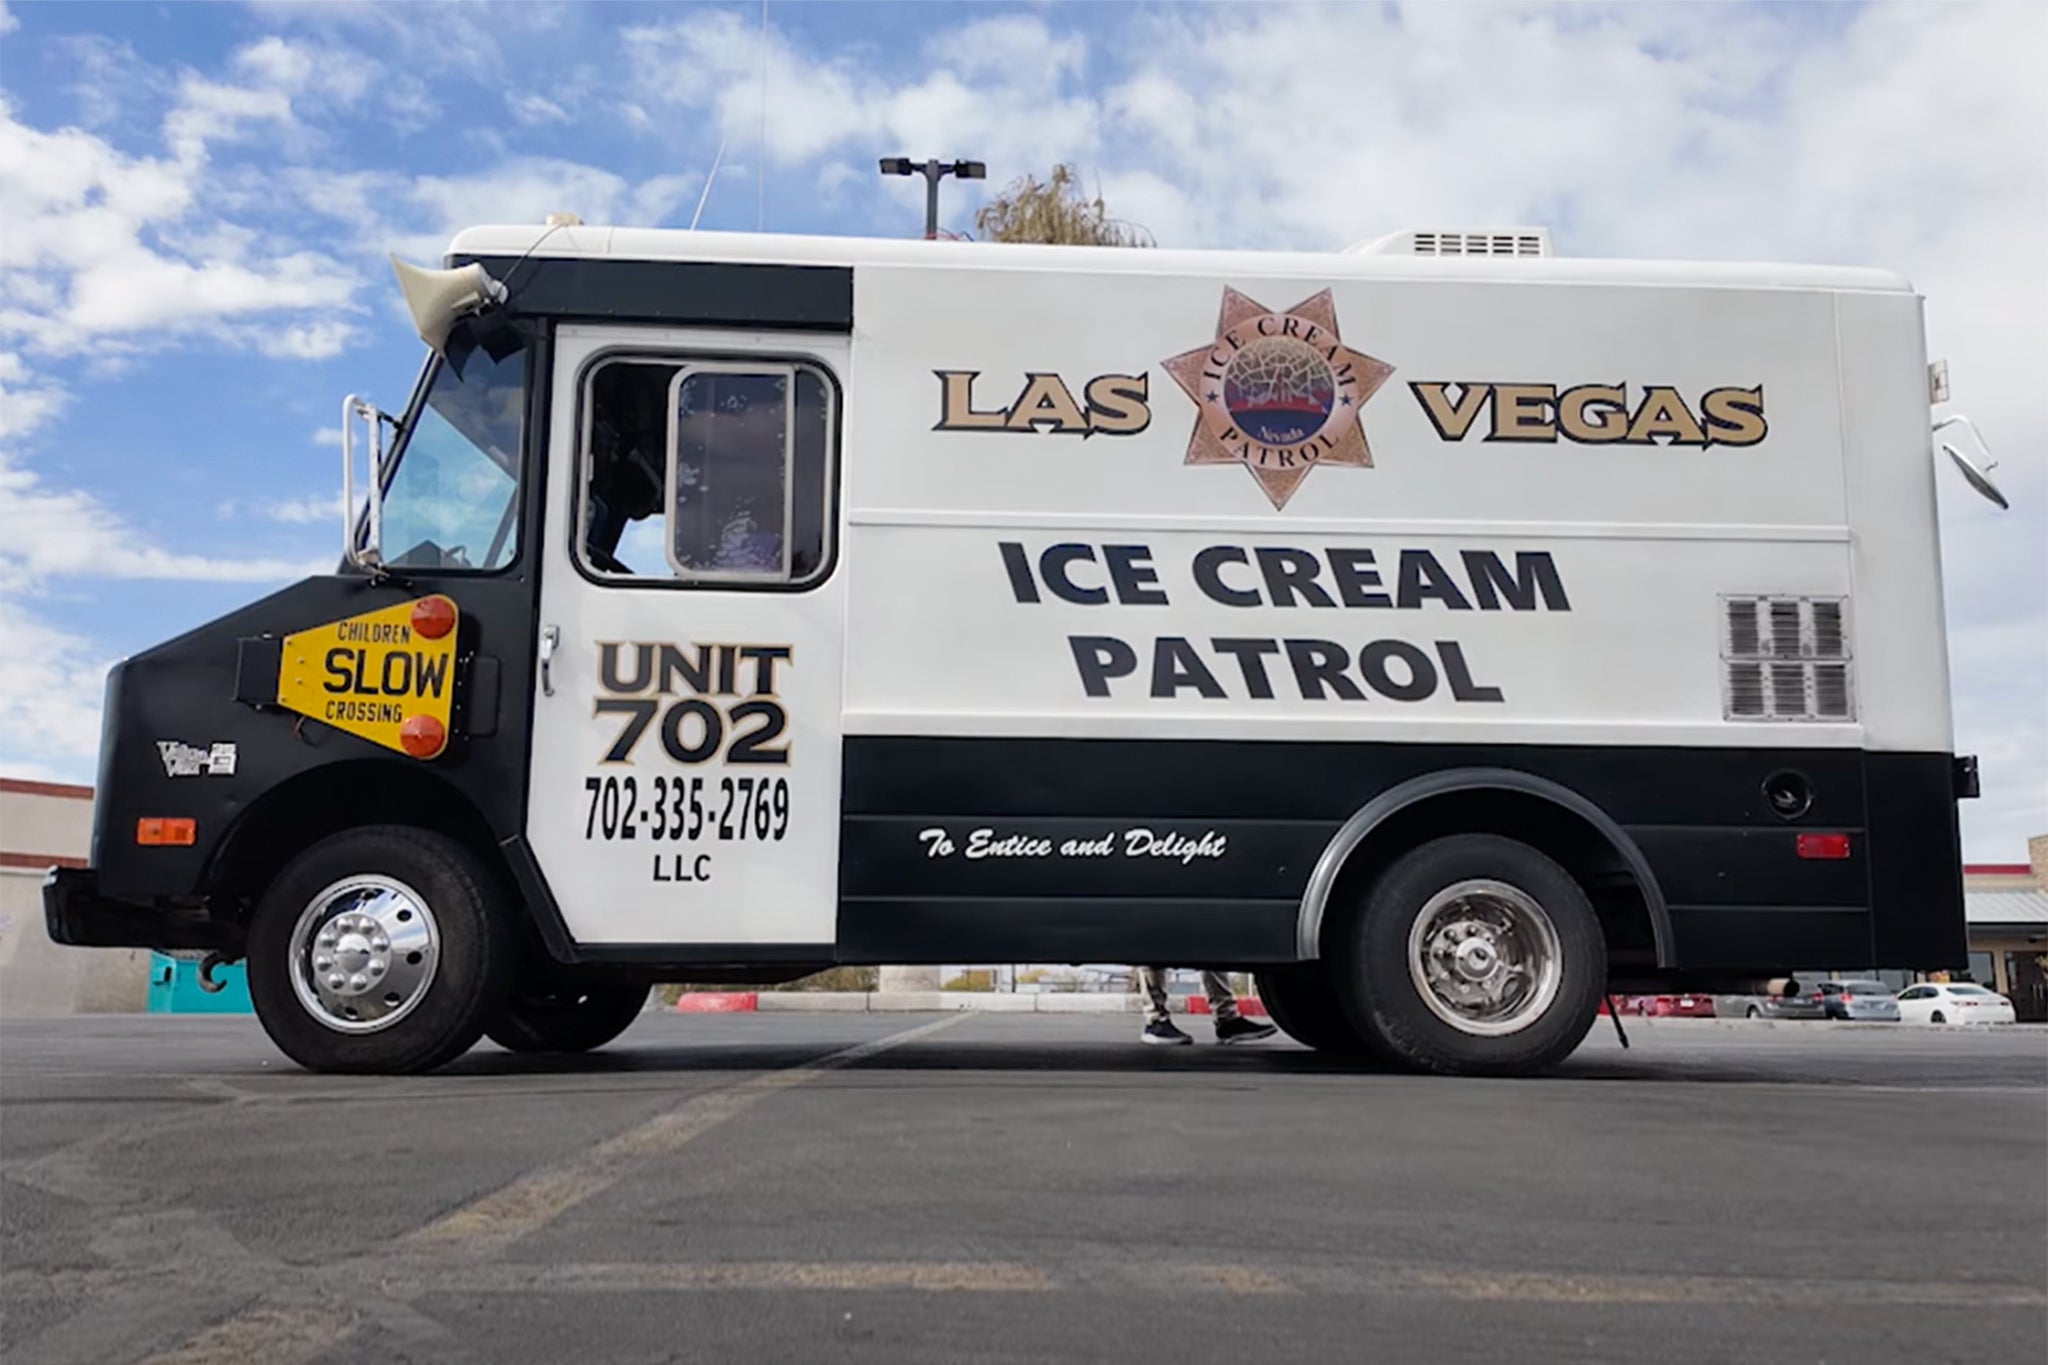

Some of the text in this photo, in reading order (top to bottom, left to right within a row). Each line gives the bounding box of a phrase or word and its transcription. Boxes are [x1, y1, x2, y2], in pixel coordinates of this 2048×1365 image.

[1203, 317, 1357, 388] ICE CREAM
[932, 370, 1768, 451] LAS VEGAS
[1257, 425, 1305, 442] Nevada
[1219, 426, 1340, 468] PATROL
[997, 542, 1572, 612] ICE CREAM
[337, 620, 411, 644] CHILDREN
[322, 648, 451, 701] SLOW
[592, 639, 795, 698] UNIT
[1068, 634, 1504, 703] PATROL
[325, 700, 404, 725] CROSSING
[592, 698, 793, 768] 702
[584, 775, 789, 841] 702-335-2769
[652, 854, 712, 882] LLC
[919, 828, 1226, 864] To Entice and Delight
